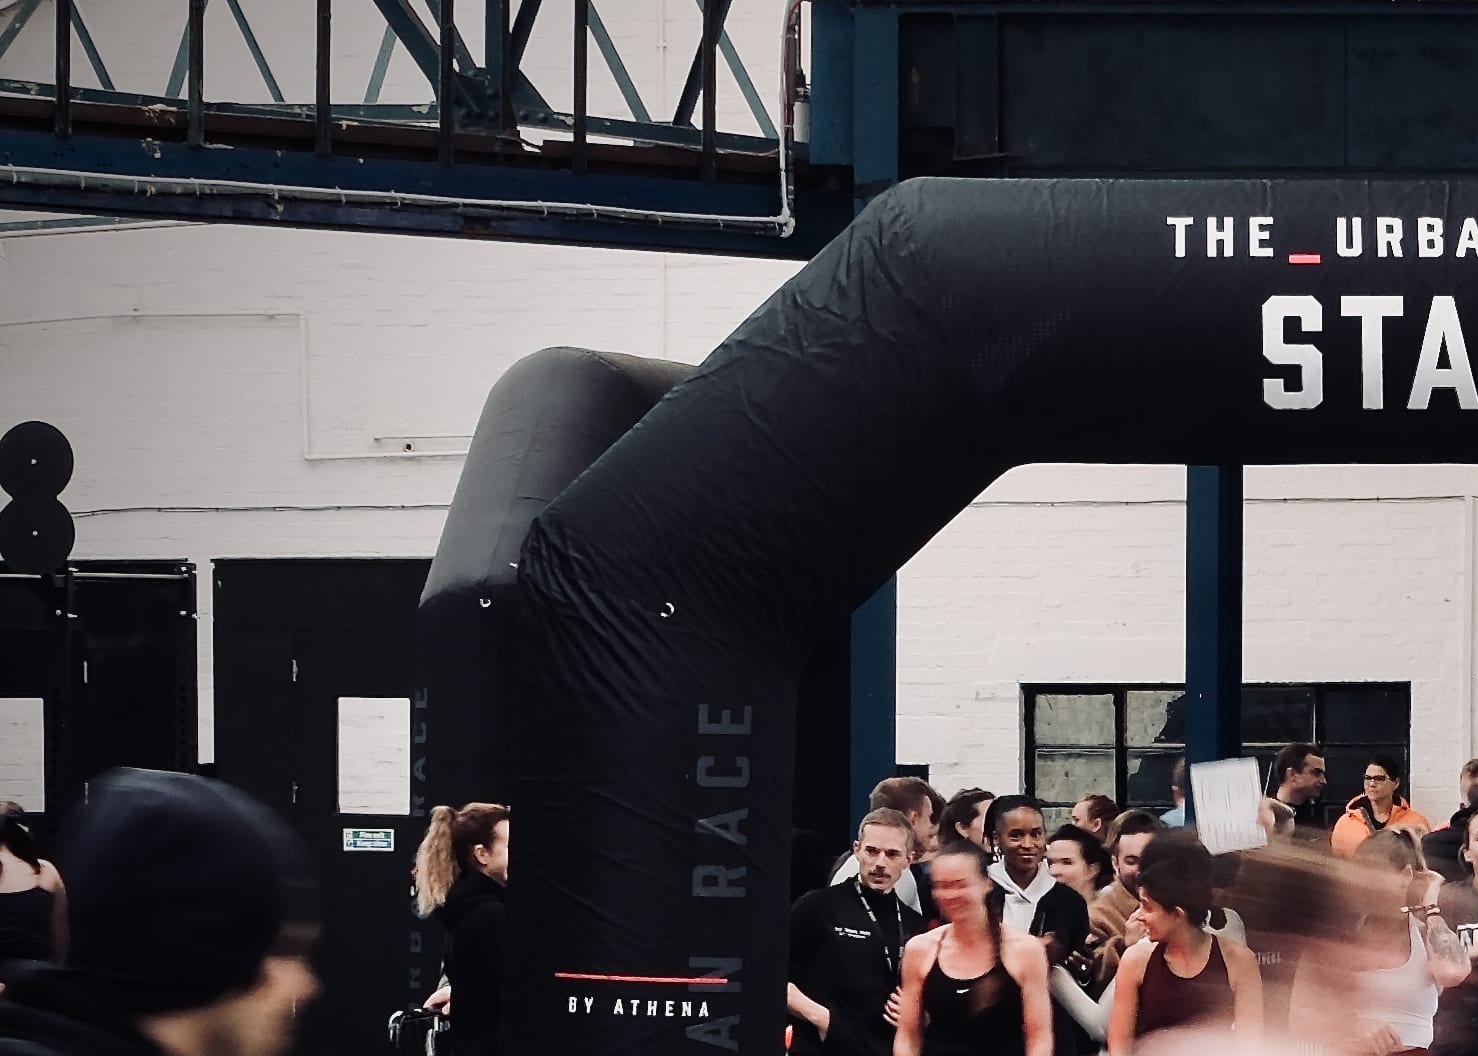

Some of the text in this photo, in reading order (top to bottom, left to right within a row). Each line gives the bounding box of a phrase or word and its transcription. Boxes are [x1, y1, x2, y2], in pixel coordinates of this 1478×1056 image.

[691, 703, 753, 898] RACE
[568, 996, 709, 1017] BY ATHENA
